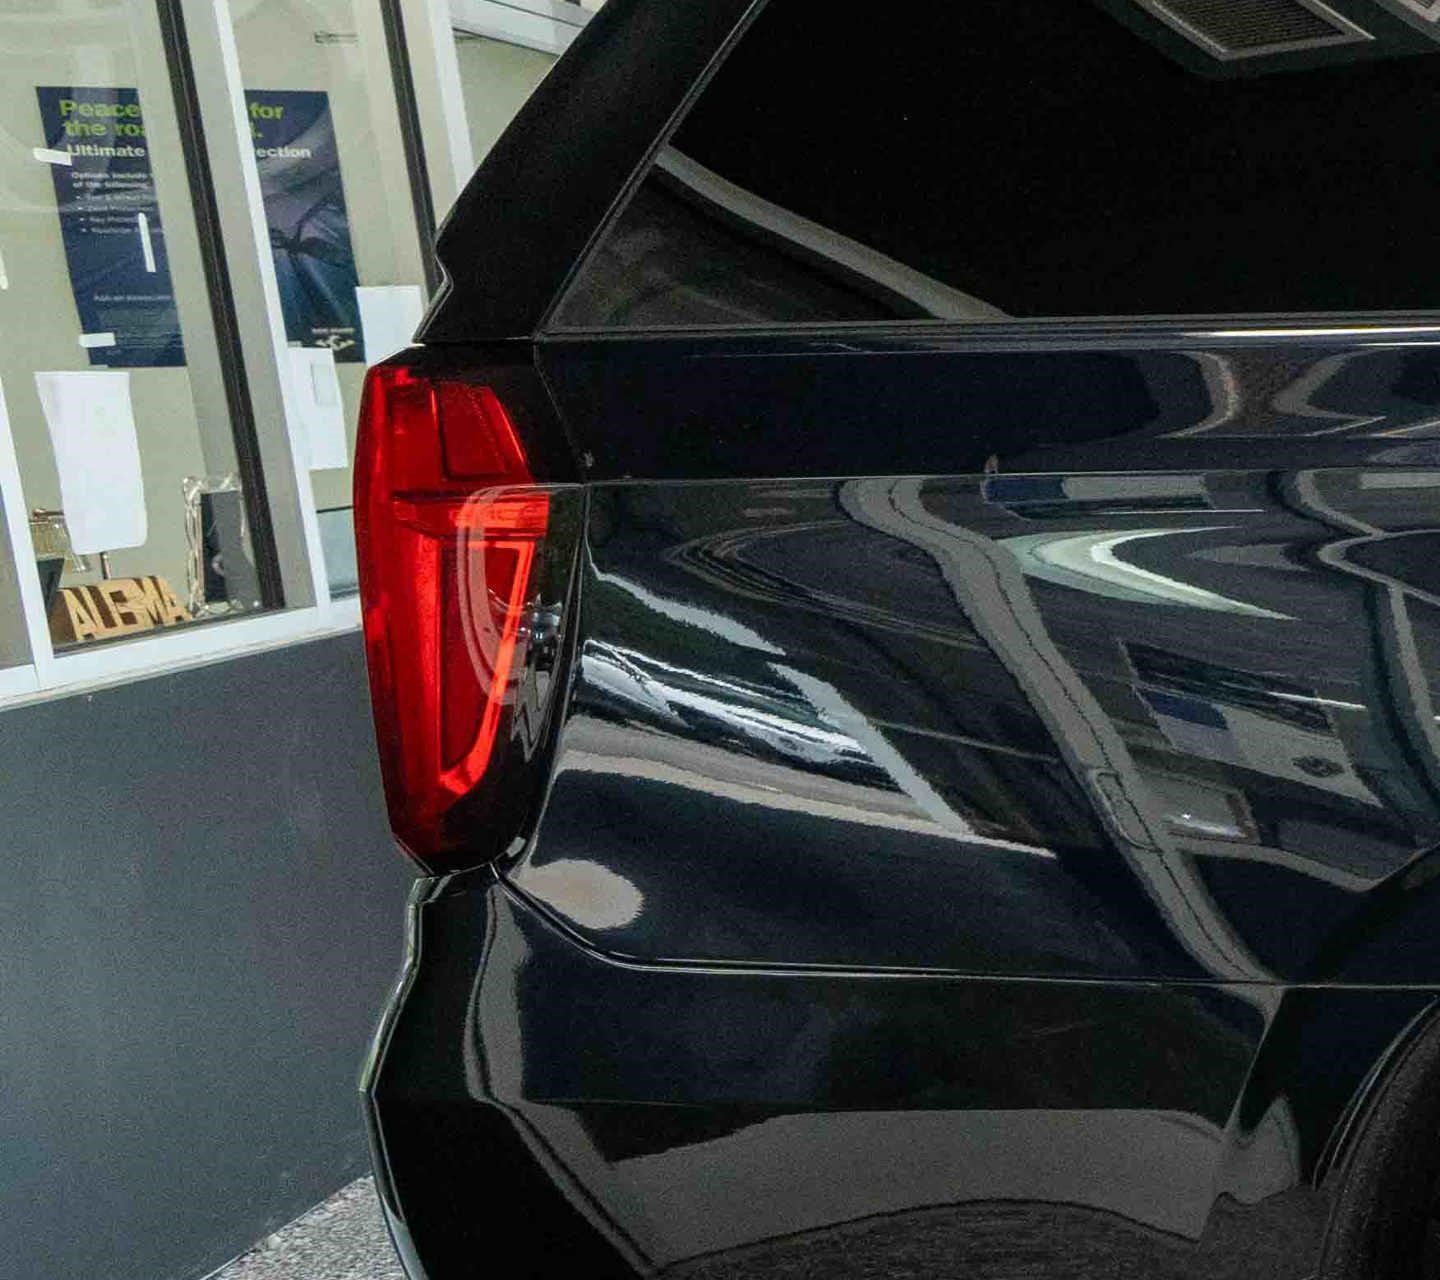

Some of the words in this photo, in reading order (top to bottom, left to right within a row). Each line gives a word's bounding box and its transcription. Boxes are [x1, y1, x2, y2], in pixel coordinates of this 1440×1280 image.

[59, 99, 140, 117] Peace
[250, 102, 284, 120] for
[62, 120, 106, 136] the
[67, 144, 145, 158] Ultimate
[256, 145, 313, 159] ection
